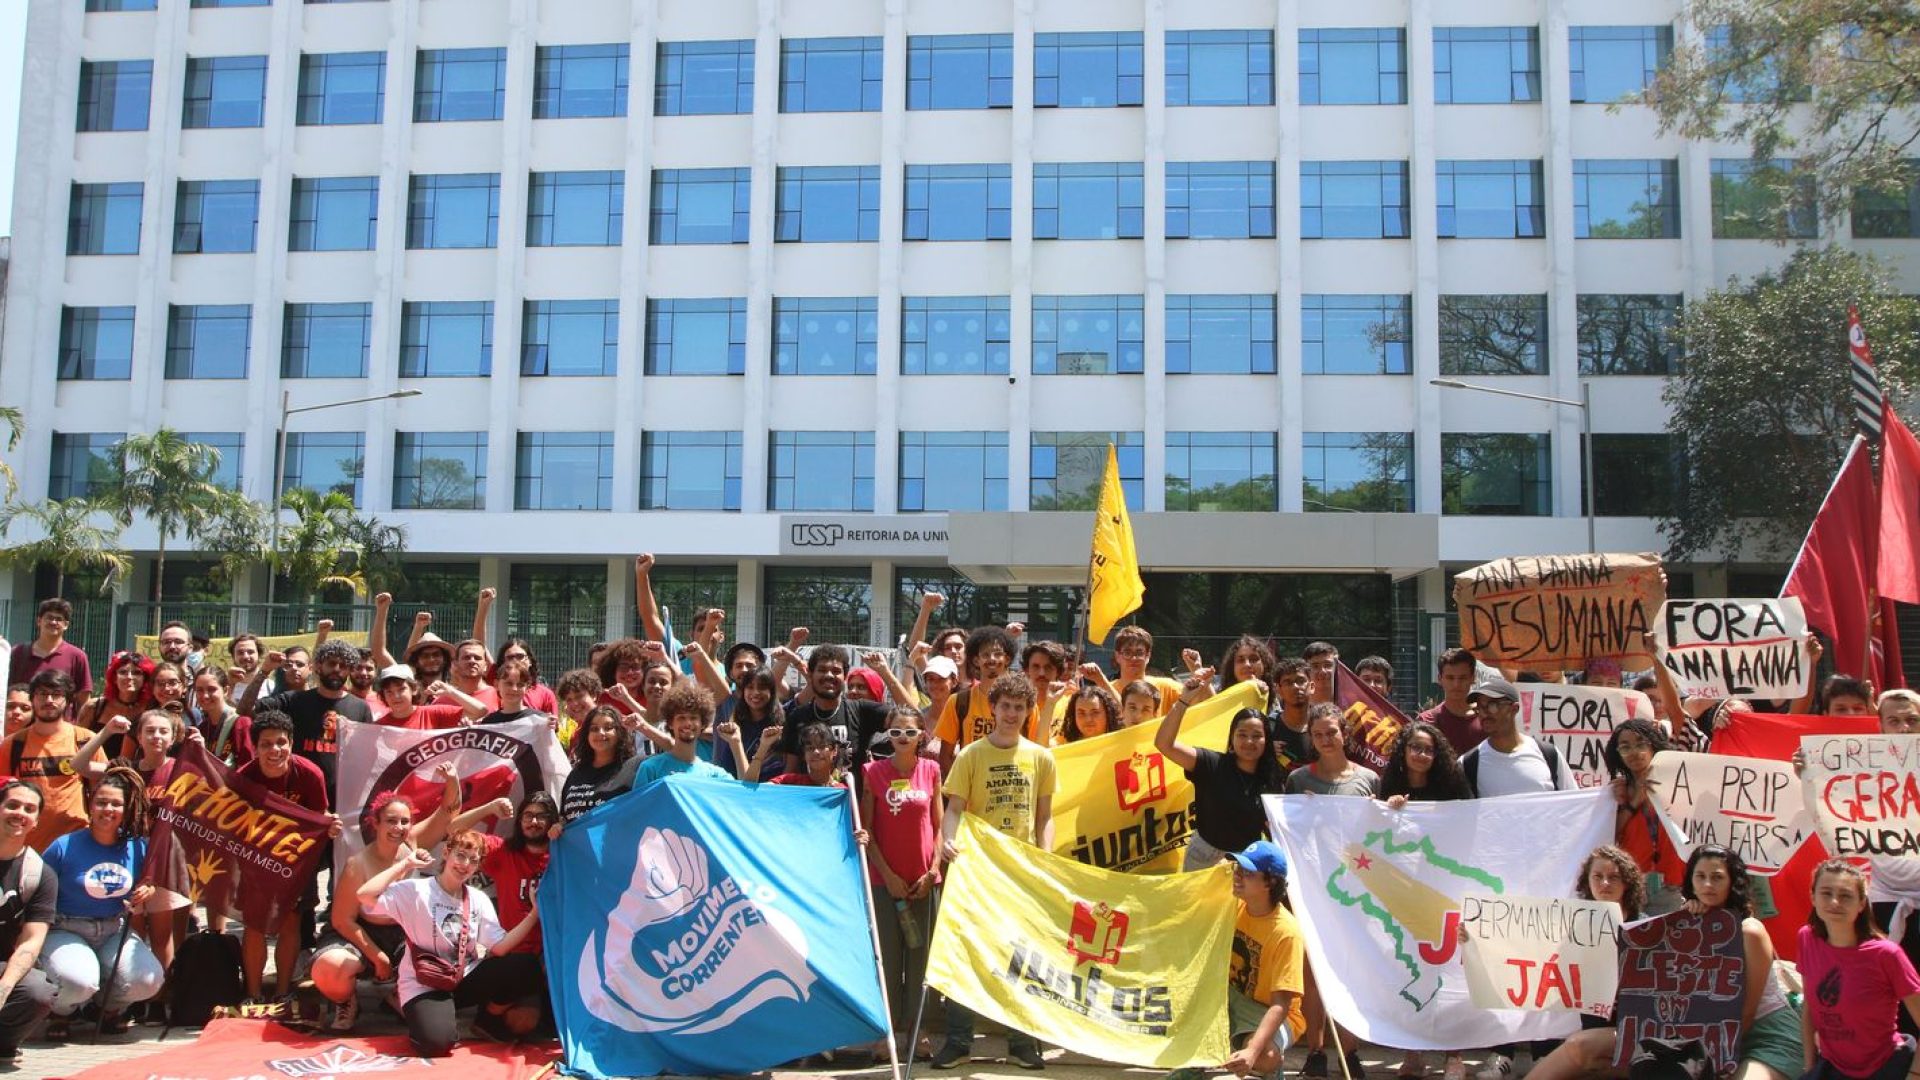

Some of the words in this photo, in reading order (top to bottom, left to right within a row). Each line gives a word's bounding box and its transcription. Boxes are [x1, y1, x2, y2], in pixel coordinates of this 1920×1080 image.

[792, 524, 843, 546] USP
[847, 530, 900, 541] REITORIA
[903, 531, 920, 541] DA
[1472, 557, 1526, 596] ANA
[1536, 553, 1616, 588] LANNA
[1467, 593, 1650, 661] DESUMANA
[1666, 601, 1786, 650] FORA
[1665, 649, 1718, 682] ANA
[1721, 640, 1801, 695] LANNA
[1540, 692, 1613, 731] FORA
[406, 732, 519, 768] GEOGRAFIA
[1822, 738, 1920, 771] GREV
[1670, 760, 1694, 806] A
[1719, 765, 1790, 813] PRIP
[164, 772, 317, 863] AFRONTE!
[1835, 827, 1920, 856] EDUCA
[157, 807, 224, 846] JUVENTUDE
[225, 840, 255, 861] SEM
[254, 853, 293, 879] MEDO
[1463, 897, 1619, 947] PERMANÊNCIA
[1506, 953, 1584, 1009] JÁ!
[1619, 948, 1744, 1001] LESTE
